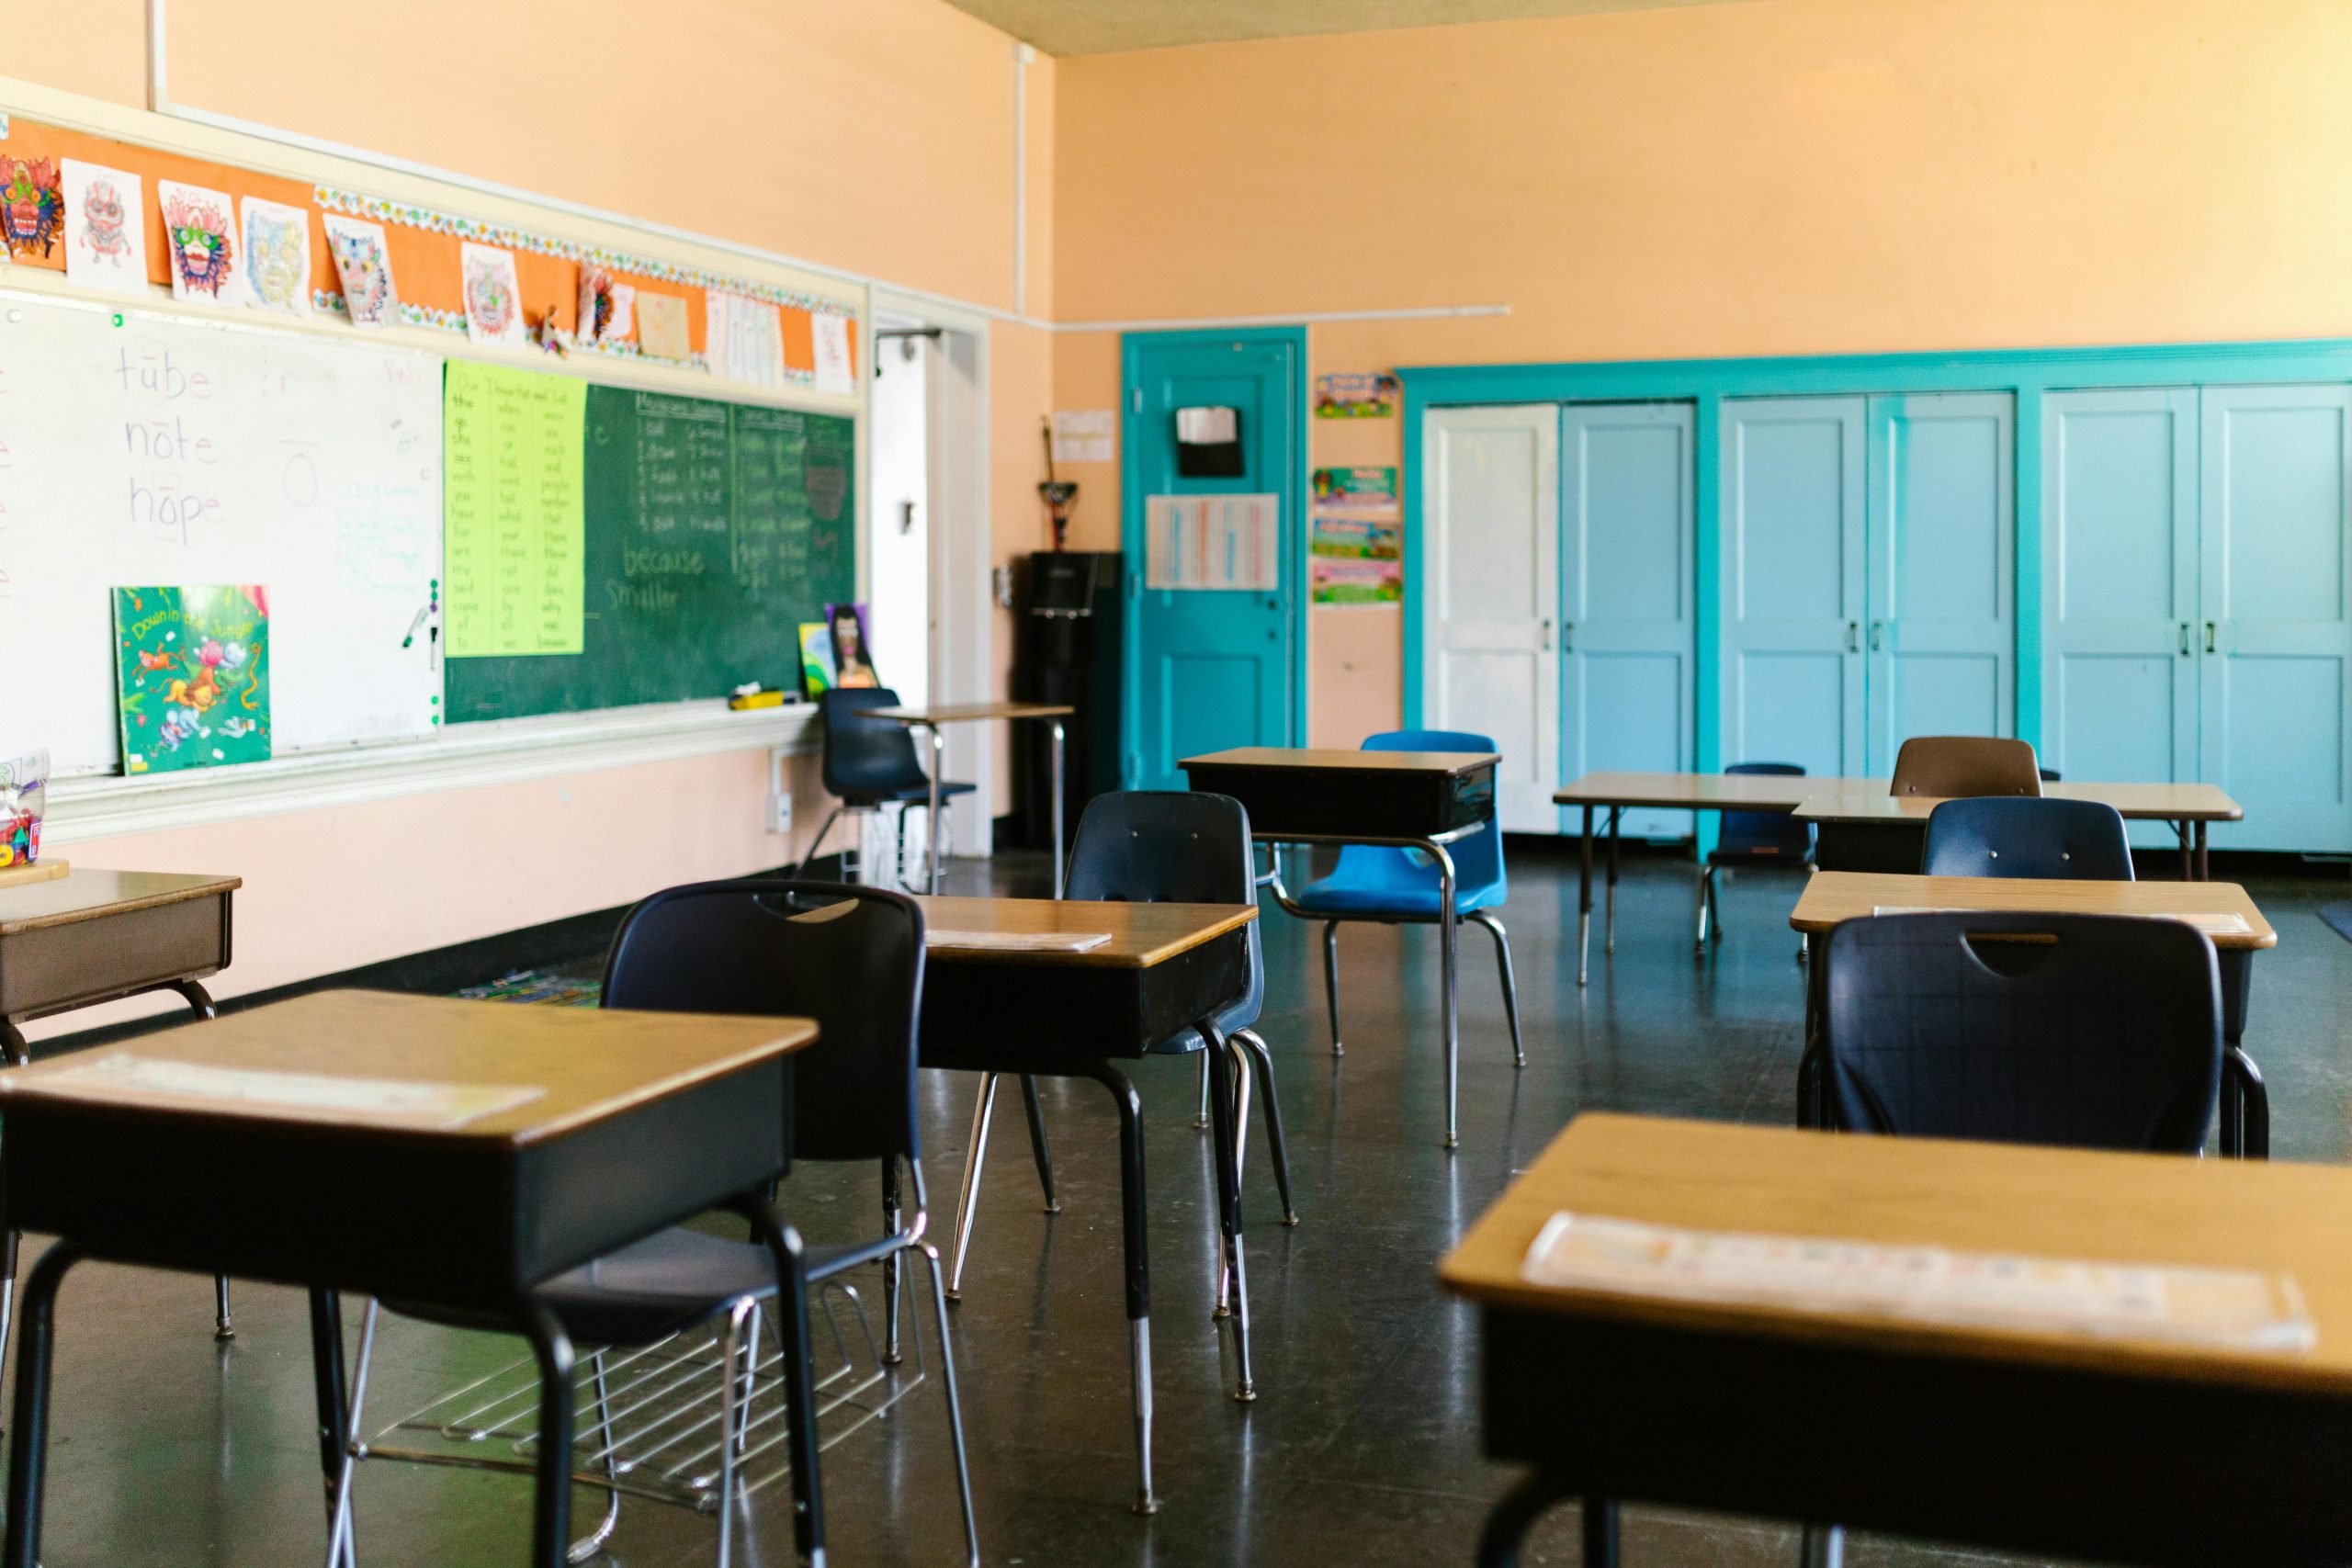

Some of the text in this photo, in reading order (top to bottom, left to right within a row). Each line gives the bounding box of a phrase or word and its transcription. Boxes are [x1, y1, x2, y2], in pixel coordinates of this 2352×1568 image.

[623, 536, 707, 578] because
[131, 610, 166, 640] Down
[168, 609, 180, 621] in
[209, 617, 254, 639] Jungle
